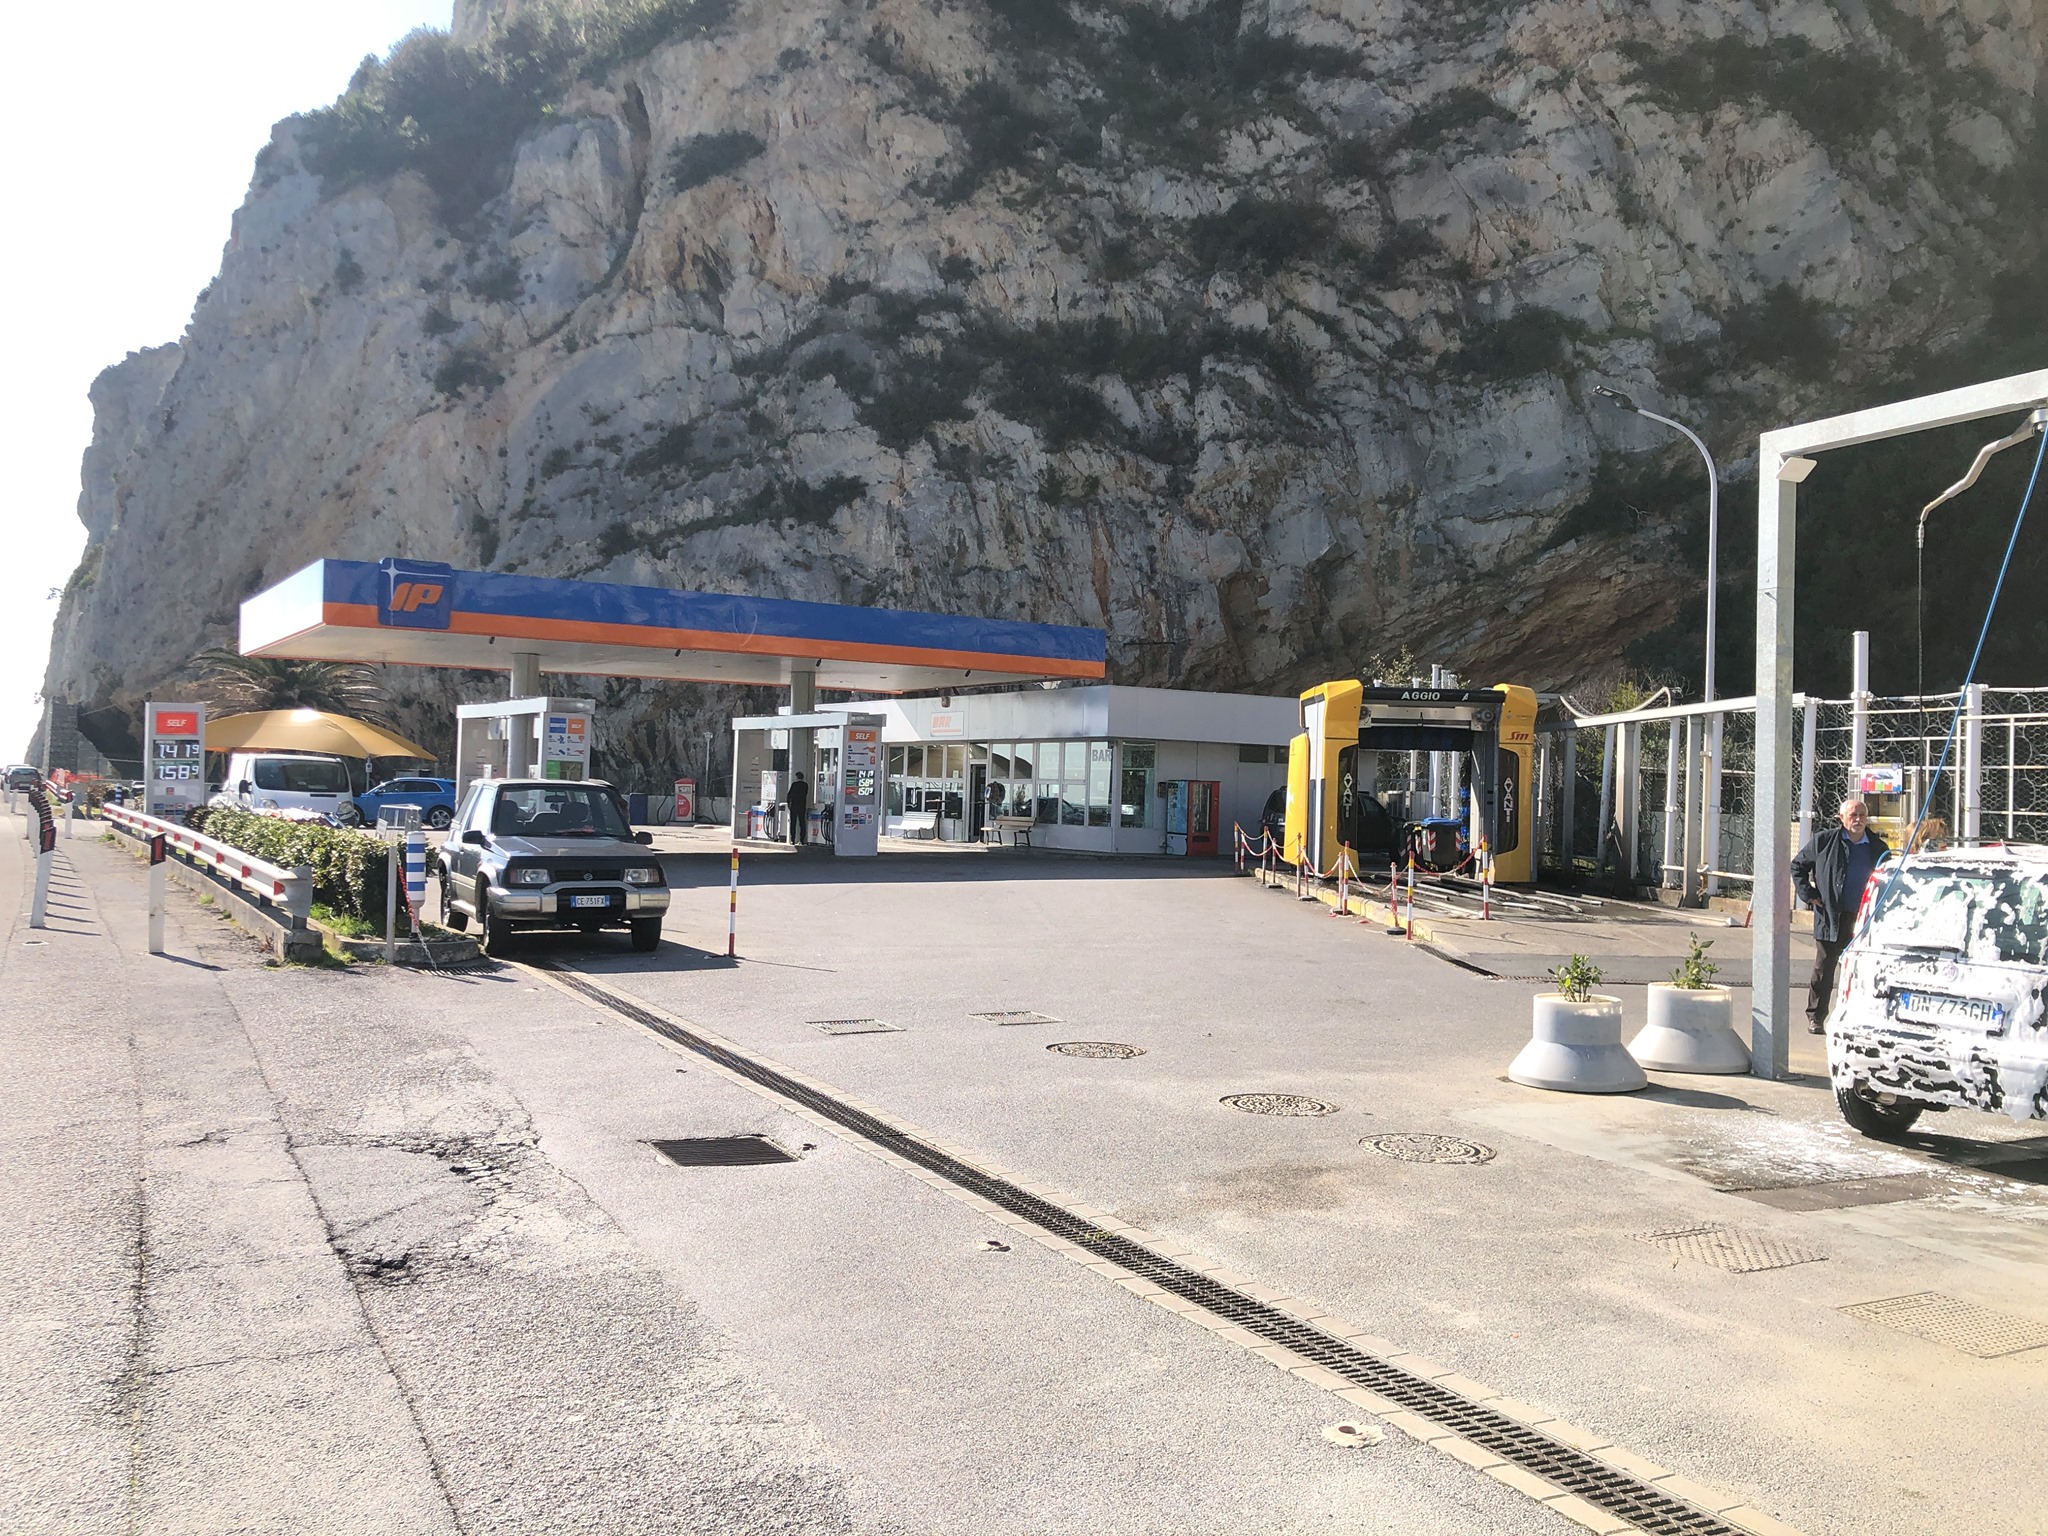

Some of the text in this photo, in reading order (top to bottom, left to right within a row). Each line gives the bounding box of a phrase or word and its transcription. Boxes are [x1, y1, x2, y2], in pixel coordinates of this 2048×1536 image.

[388, 582, 444, 612] IP
[1401, 691, 1440, 701] AGGIO
[166, 719, 187, 727] SELF
[855, 732, 870, 740] SELF
[1092, 749, 1112, 762] BAR
[1343, 772, 1353, 818] AVANTI
[1503, 777, 1513, 823] AVANTI
